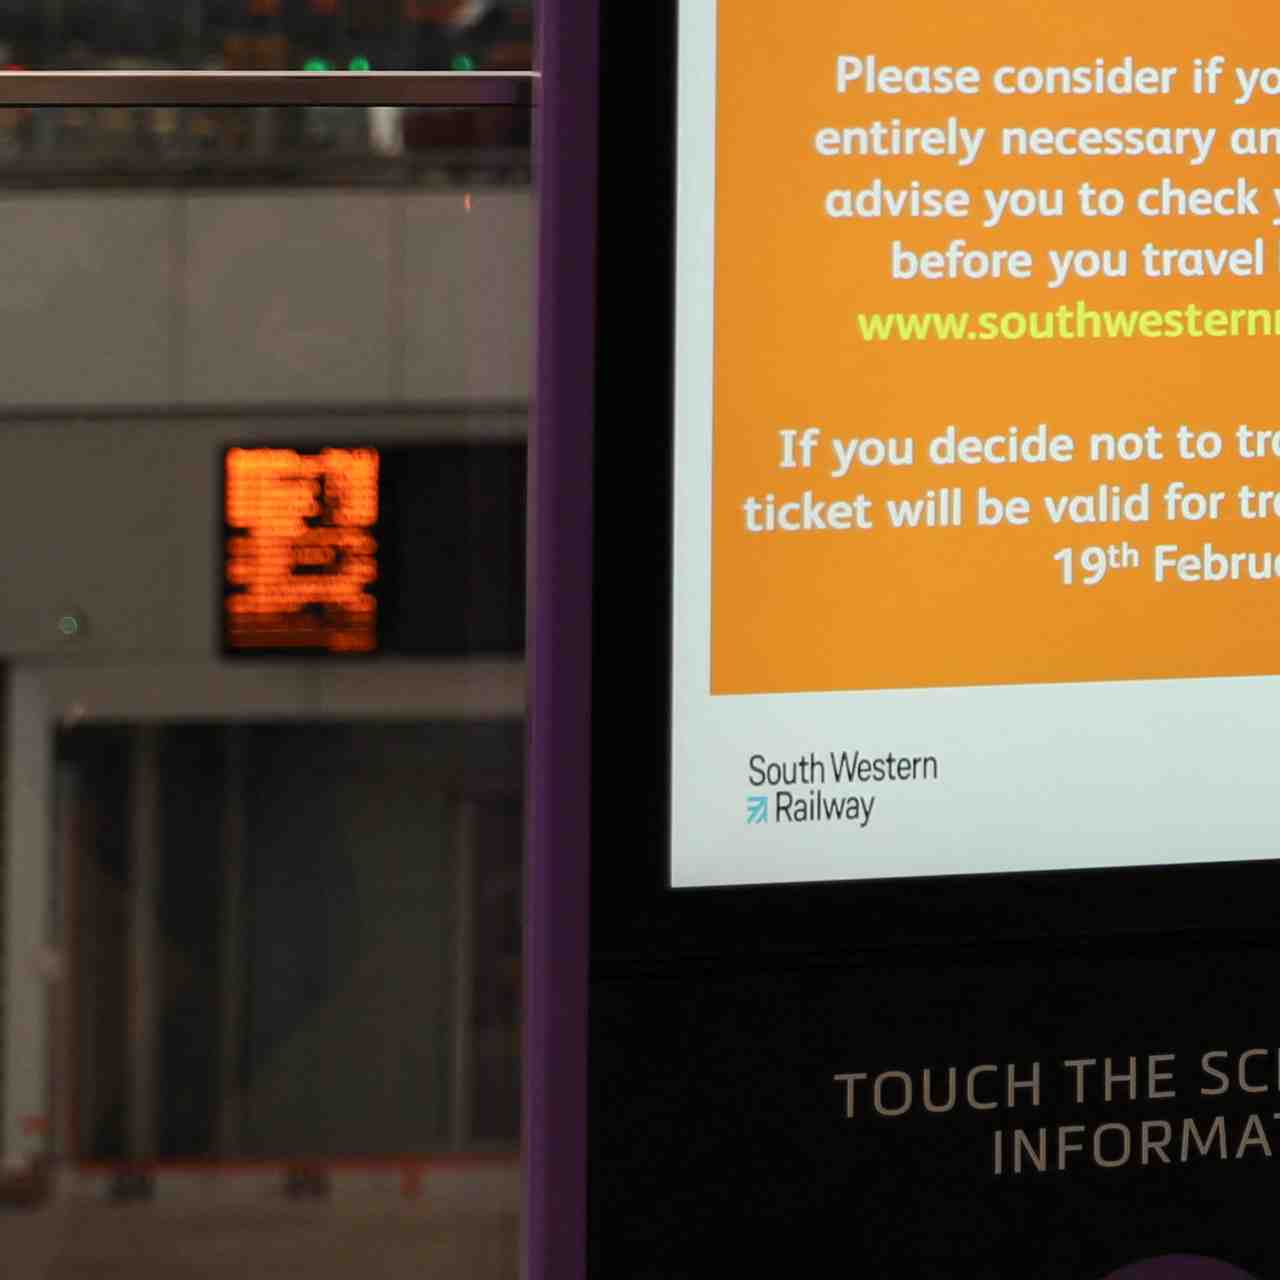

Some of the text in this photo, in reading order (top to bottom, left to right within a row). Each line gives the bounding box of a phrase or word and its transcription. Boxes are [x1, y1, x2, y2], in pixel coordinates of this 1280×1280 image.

[836, 54, 982, 95] Please
[992, 55, 1178, 96] consider
[1192, 55, 1225, 95] if
[814, 116, 986, 167] entirely
[1001, 127, 1217, 166] necessary
[824, 178, 971, 219] advise
[983, 188, 1064, 229] you
[1077, 182, 1125, 217] to
[1136, 177, 1260, 217] check
[890, 239, 1033, 280] before
[1047, 249, 1128, 289] you
[1141, 237, 1265, 278] travel
[779, 427, 821, 469] If
[831, 437, 914, 478] you
[928, 423, 1075, 466] decide
[1090, 425, 1164, 461] not
[1176, 425, 1223, 460] to
[743, 490, 873, 533] ticket
[886, 487, 962, 529] will
[976, 486, 1031, 528] be
[1043, 482, 1150, 524] valid
[1163, 481, 1225, 521] for
[1053, 541, 1141, 586] 19th
[748, 749, 938, 787] South Western
[775, 788, 876, 828] Railway
[834, 1062, 1039, 1117] TOUCH
[1064, 1054, 1175, 1102] THE
